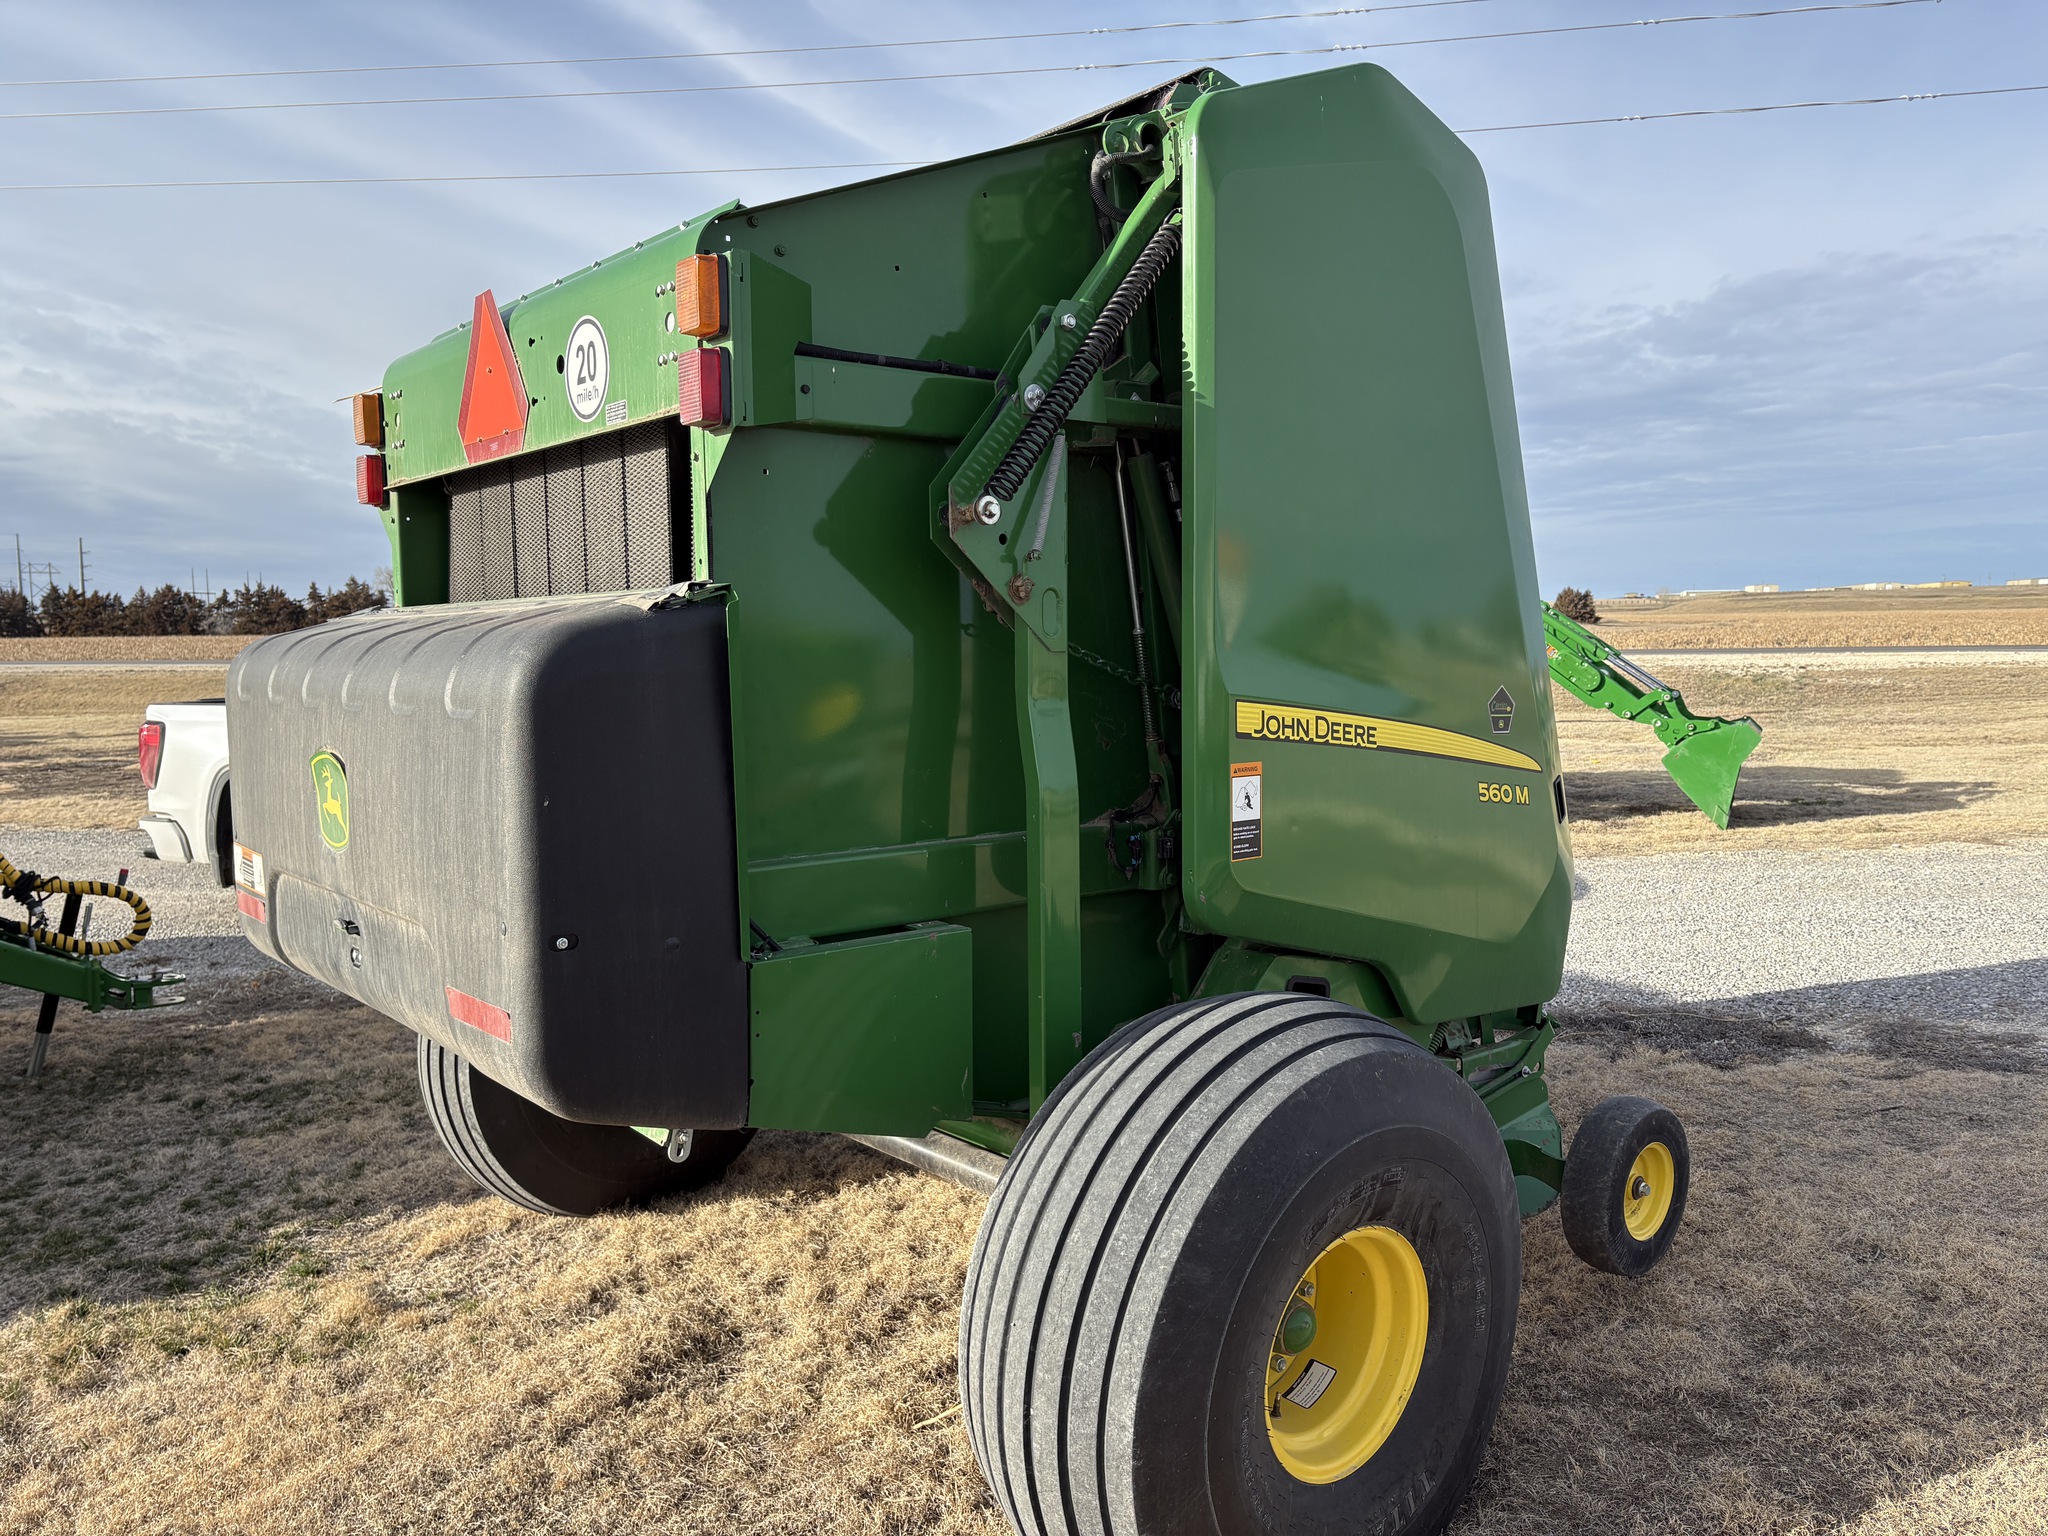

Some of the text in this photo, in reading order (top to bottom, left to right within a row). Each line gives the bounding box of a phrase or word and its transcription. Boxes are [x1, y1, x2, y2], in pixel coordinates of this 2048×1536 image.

[576, 340, 596, 385] 20
[1253, 710, 1378, 745] JOHN DEERE
[1478, 781, 1530, 805] 560 M
